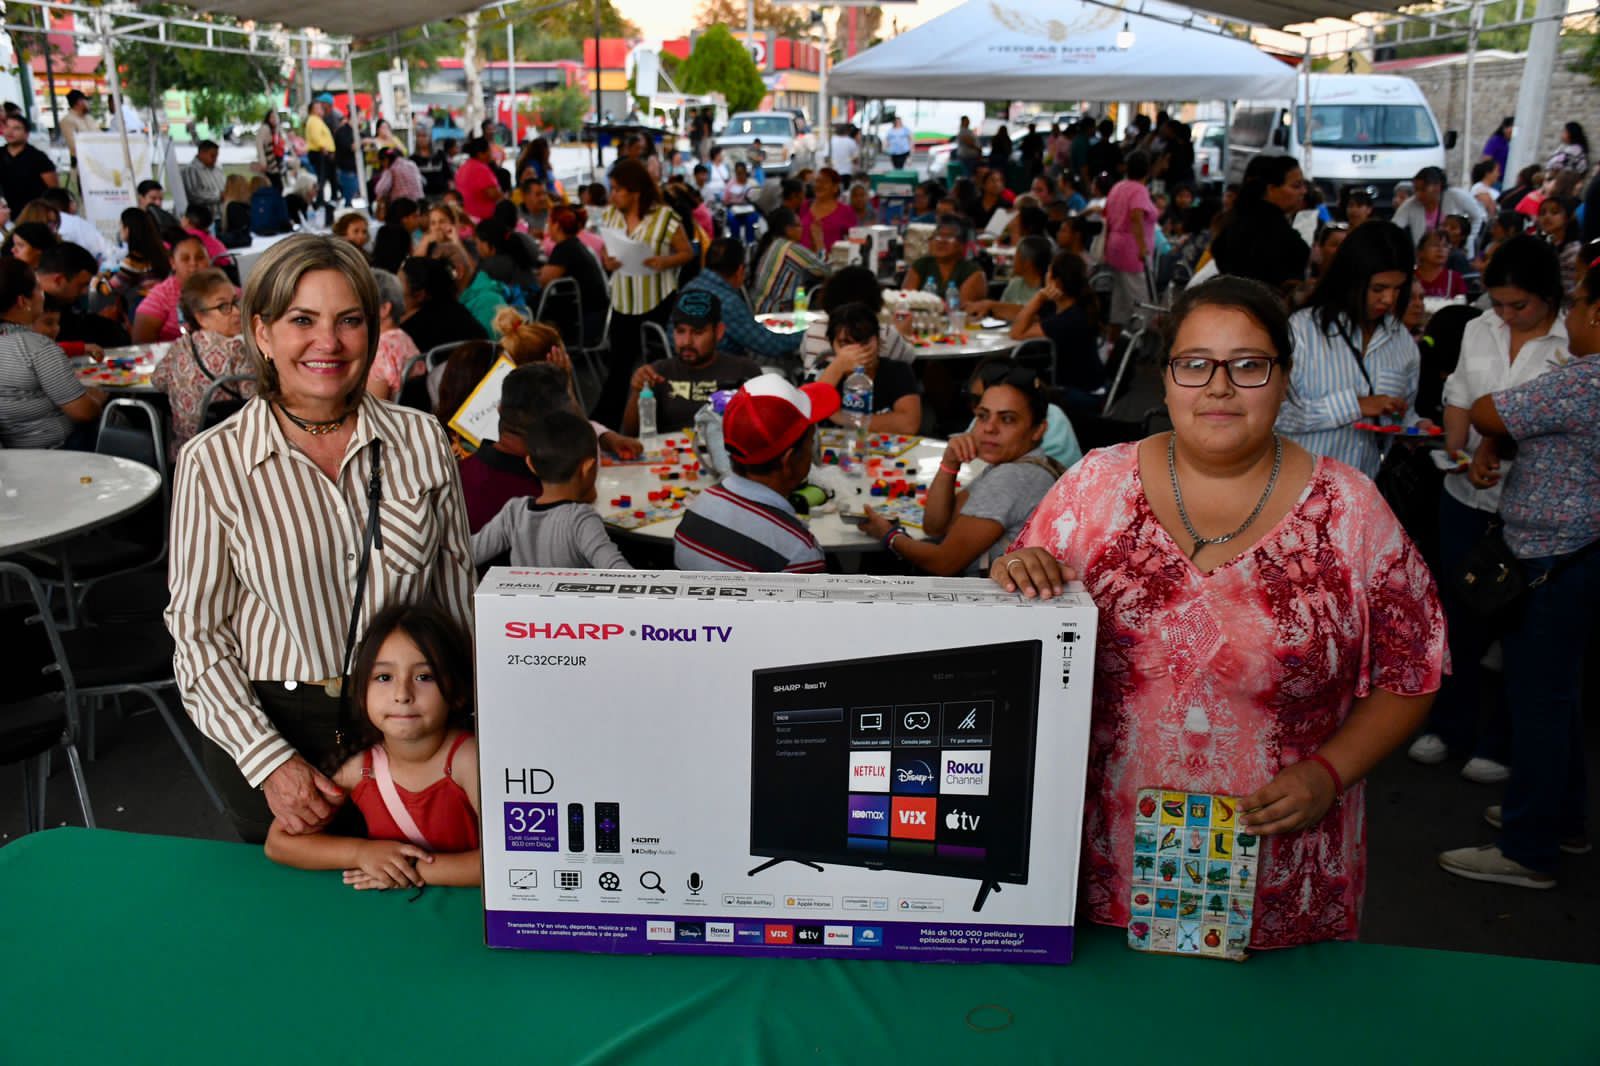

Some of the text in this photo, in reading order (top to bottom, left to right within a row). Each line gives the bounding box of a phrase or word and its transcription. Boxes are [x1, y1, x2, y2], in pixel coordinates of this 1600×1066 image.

[1352, 154, 1376, 164] DIF
[504, 622, 732, 642] SHARP Roku TV
[507, 654, 586, 666] 2T-C32CF2UR
[773, 684, 800, 692] SHARP
[854, 766, 886, 777] NETFLIX
[947, 760, 984, 774] Roku
[506, 768, 554, 794] HD
[946, 775, 983, 785] Channel
[508, 807, 555, 833] 32"
[899, 810, 928, 825] ViX
[960, 811, 980, 831] tv
[808, 930, 819, 939] tv
